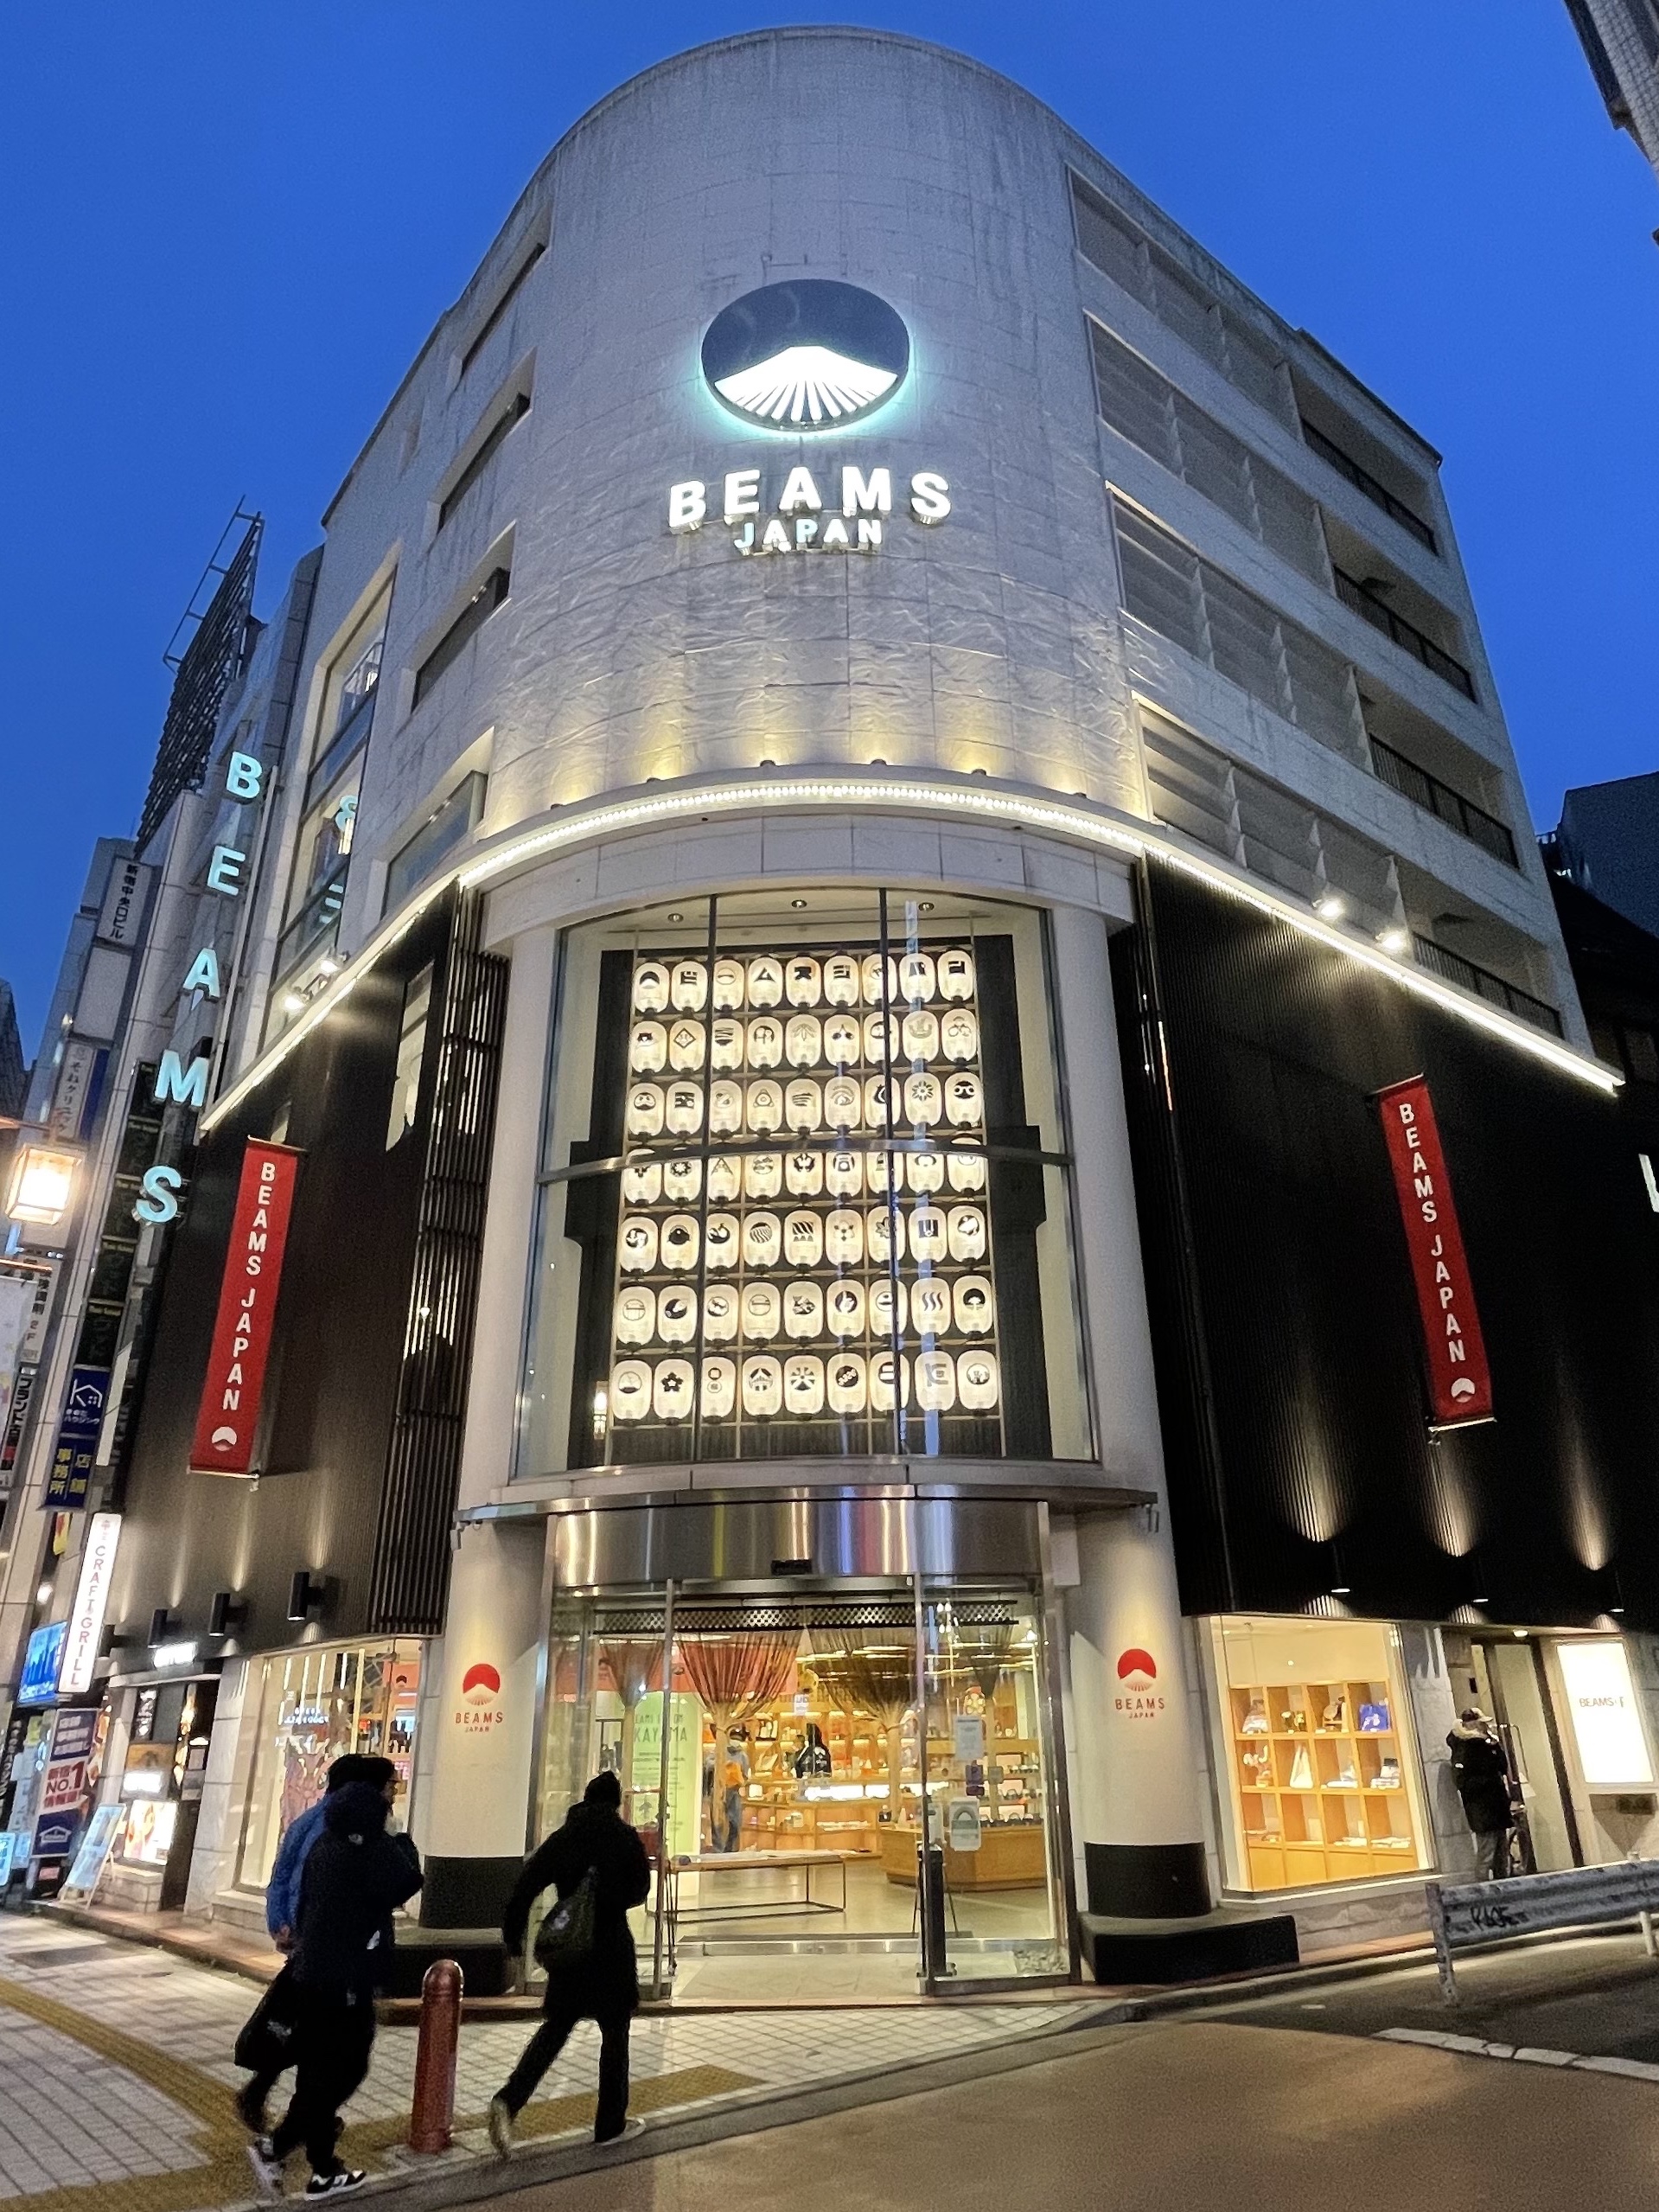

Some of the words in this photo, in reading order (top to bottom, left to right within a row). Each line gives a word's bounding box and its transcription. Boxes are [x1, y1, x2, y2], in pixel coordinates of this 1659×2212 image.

[669, 465, 951, 531] BEAMS
[734, 518, 882, 553] JAPAN
[136, 751, 263, 1223] BEAMS
[246, 1161, 276, 1276] BEAMS
[1399, 1103, 1438, 1223] BEAMS
[1431, 1234, 1465, 1363] JAPAN
[222, 1287, 256, 1411] JAPAN
[86, 1545, 106, 1611] CRAFT
[70, 1617, 93, 1685] GRILL
[455, 1711, 504, 1724] BEAMS
[1114, 1697, 1165, 1710] BEAMS
[1579, 1697, 1615, 1708] BEAMS
